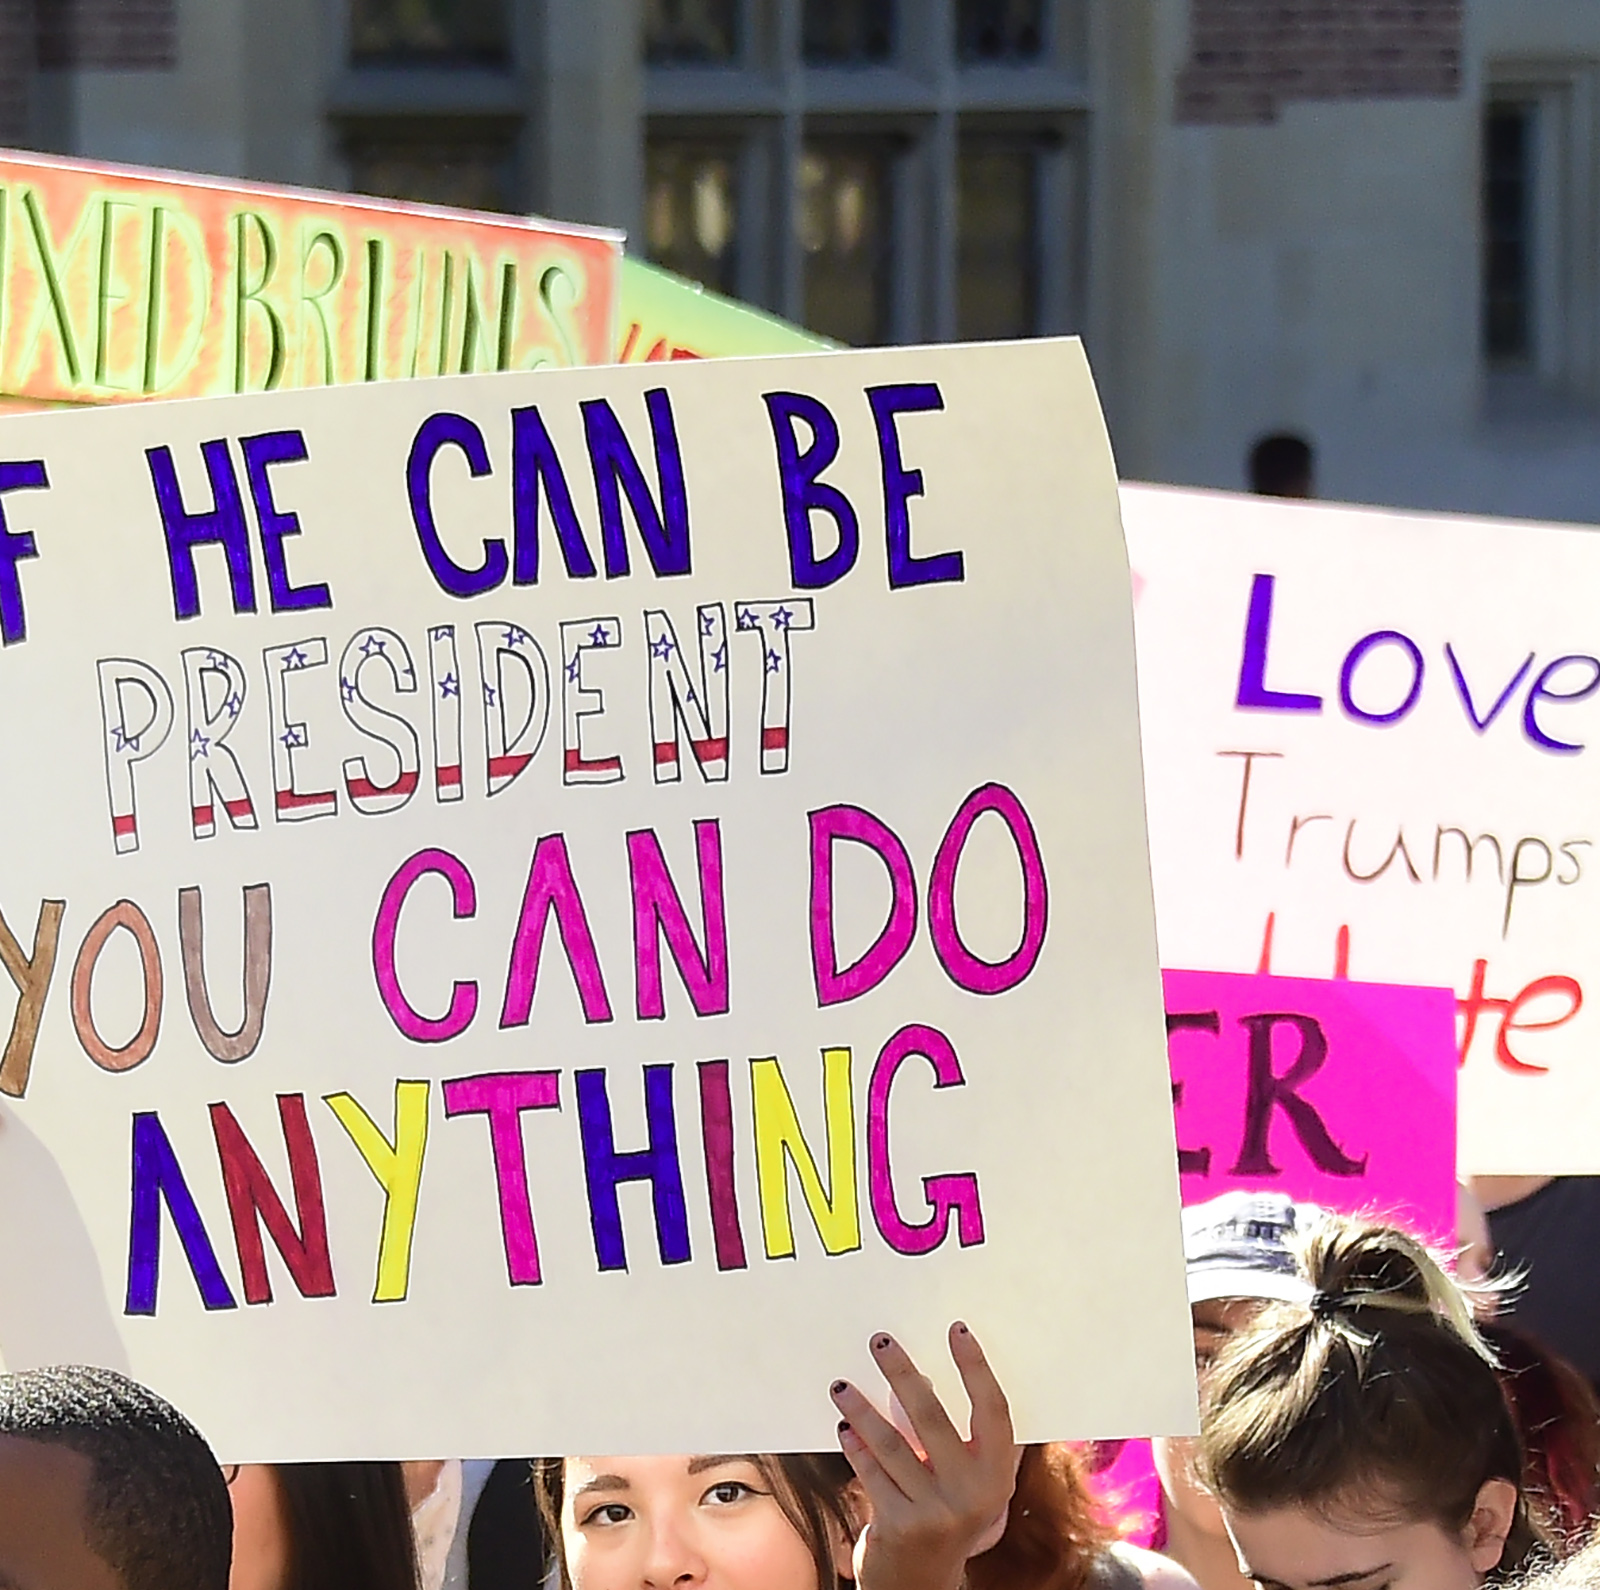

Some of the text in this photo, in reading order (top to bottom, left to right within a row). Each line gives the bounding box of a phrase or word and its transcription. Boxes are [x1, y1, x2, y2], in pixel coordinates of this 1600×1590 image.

[232, 209, 580, 393] BRUINS
[144, 428, 333, 621] HE
[405, 387, 693, 600] CAN
[760, 382, 966, 592] BE
[95, 596, 816, 856] PRESIDENT
[1215, 751, 1593, 941] Trumps
[372, 817, 731, 1045] CAN
[806, 781, 1049, 1009] DO
[123, 1023, 987, 1319] ANYTHING
